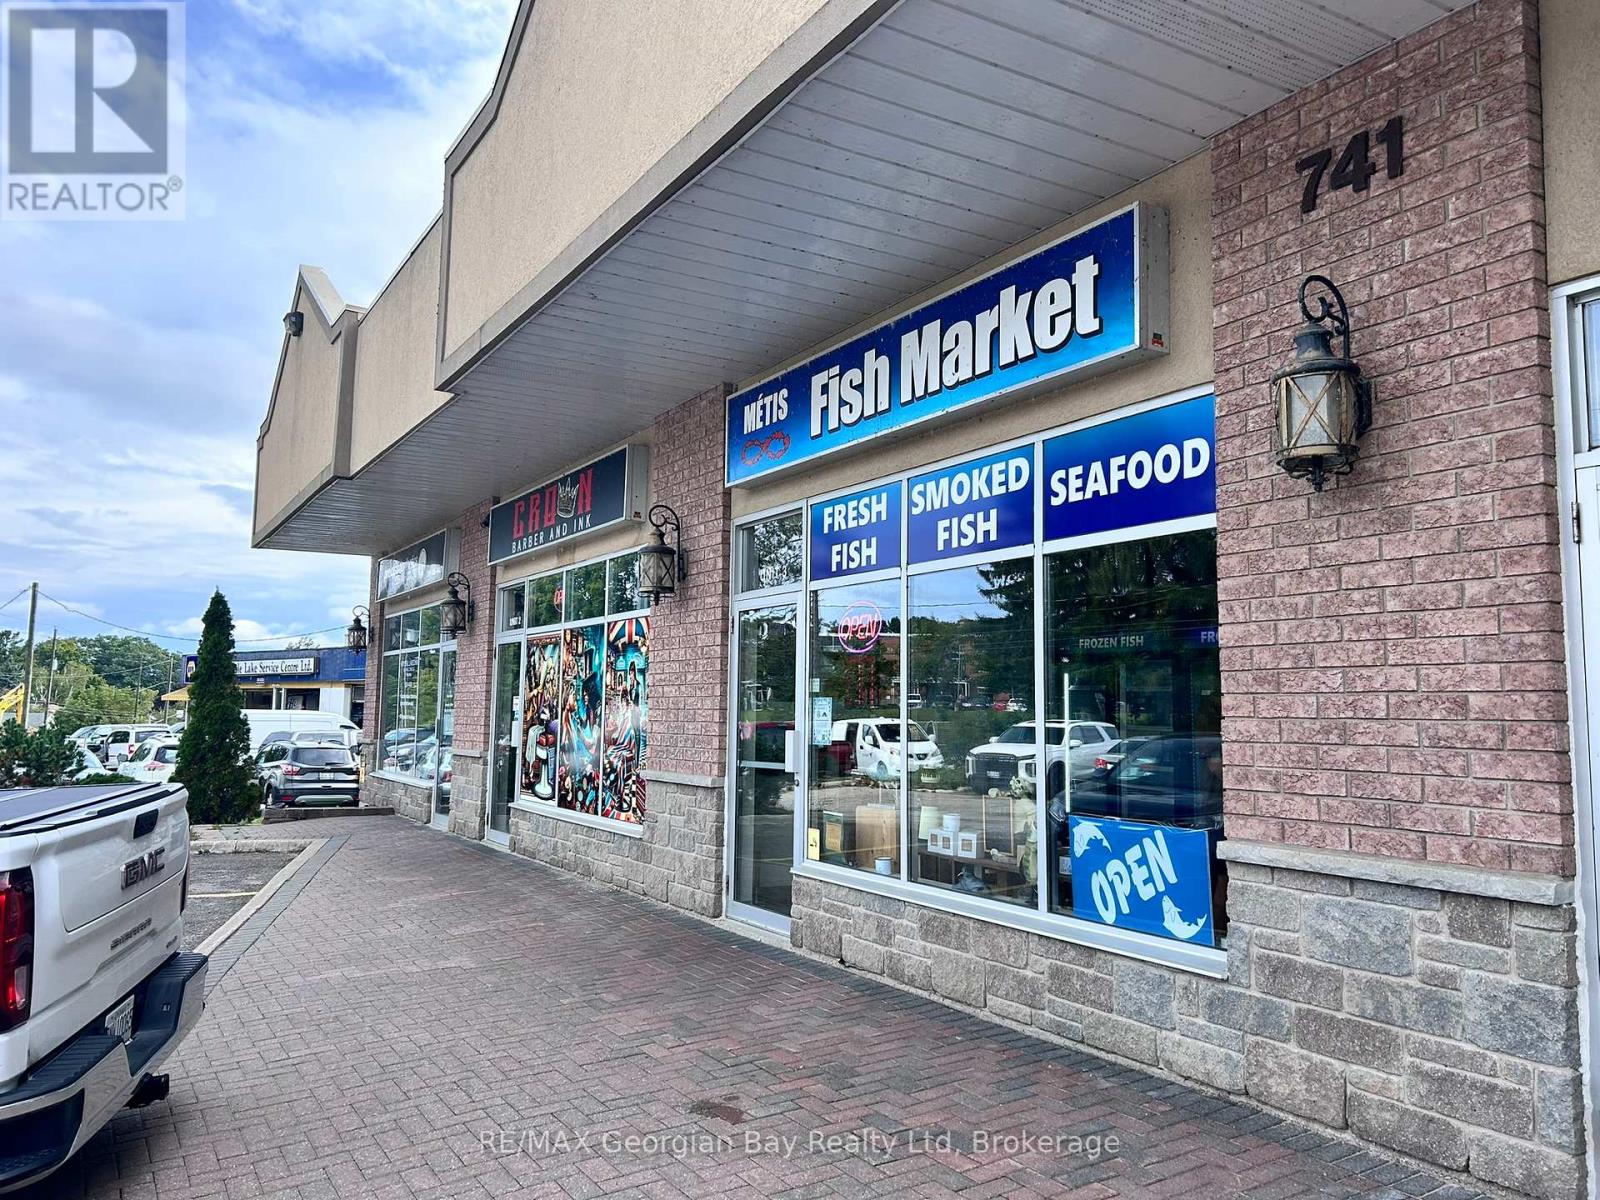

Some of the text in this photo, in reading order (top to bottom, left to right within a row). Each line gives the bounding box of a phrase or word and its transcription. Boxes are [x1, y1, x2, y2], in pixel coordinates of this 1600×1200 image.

[1295, 115, 1404, 213] 741
[810, 254, 1103, 440] Fish Market
[743, 388, 788, 435] MÉTIS
[911, 457, 1030, 515] SMOKED
[1050, 437, 1210, 506] SEAFOOD
[511, 513, 592, 554] BARBER AND INK
[823, 492, 887, 534] FRESH
[937, 508, 998, 551] FISH
[831, 537, 877, 572] FISH
[840, 613, 878, 641] OPEN
[1079, 635, 1144, 649] FROZEN FISH
[1201, 631, 1218, 643] FR
[259, 661, 279, 673] Service
[121, 846, 165, 890] GMC
[1091, 829, 1178, 925] OPEN
